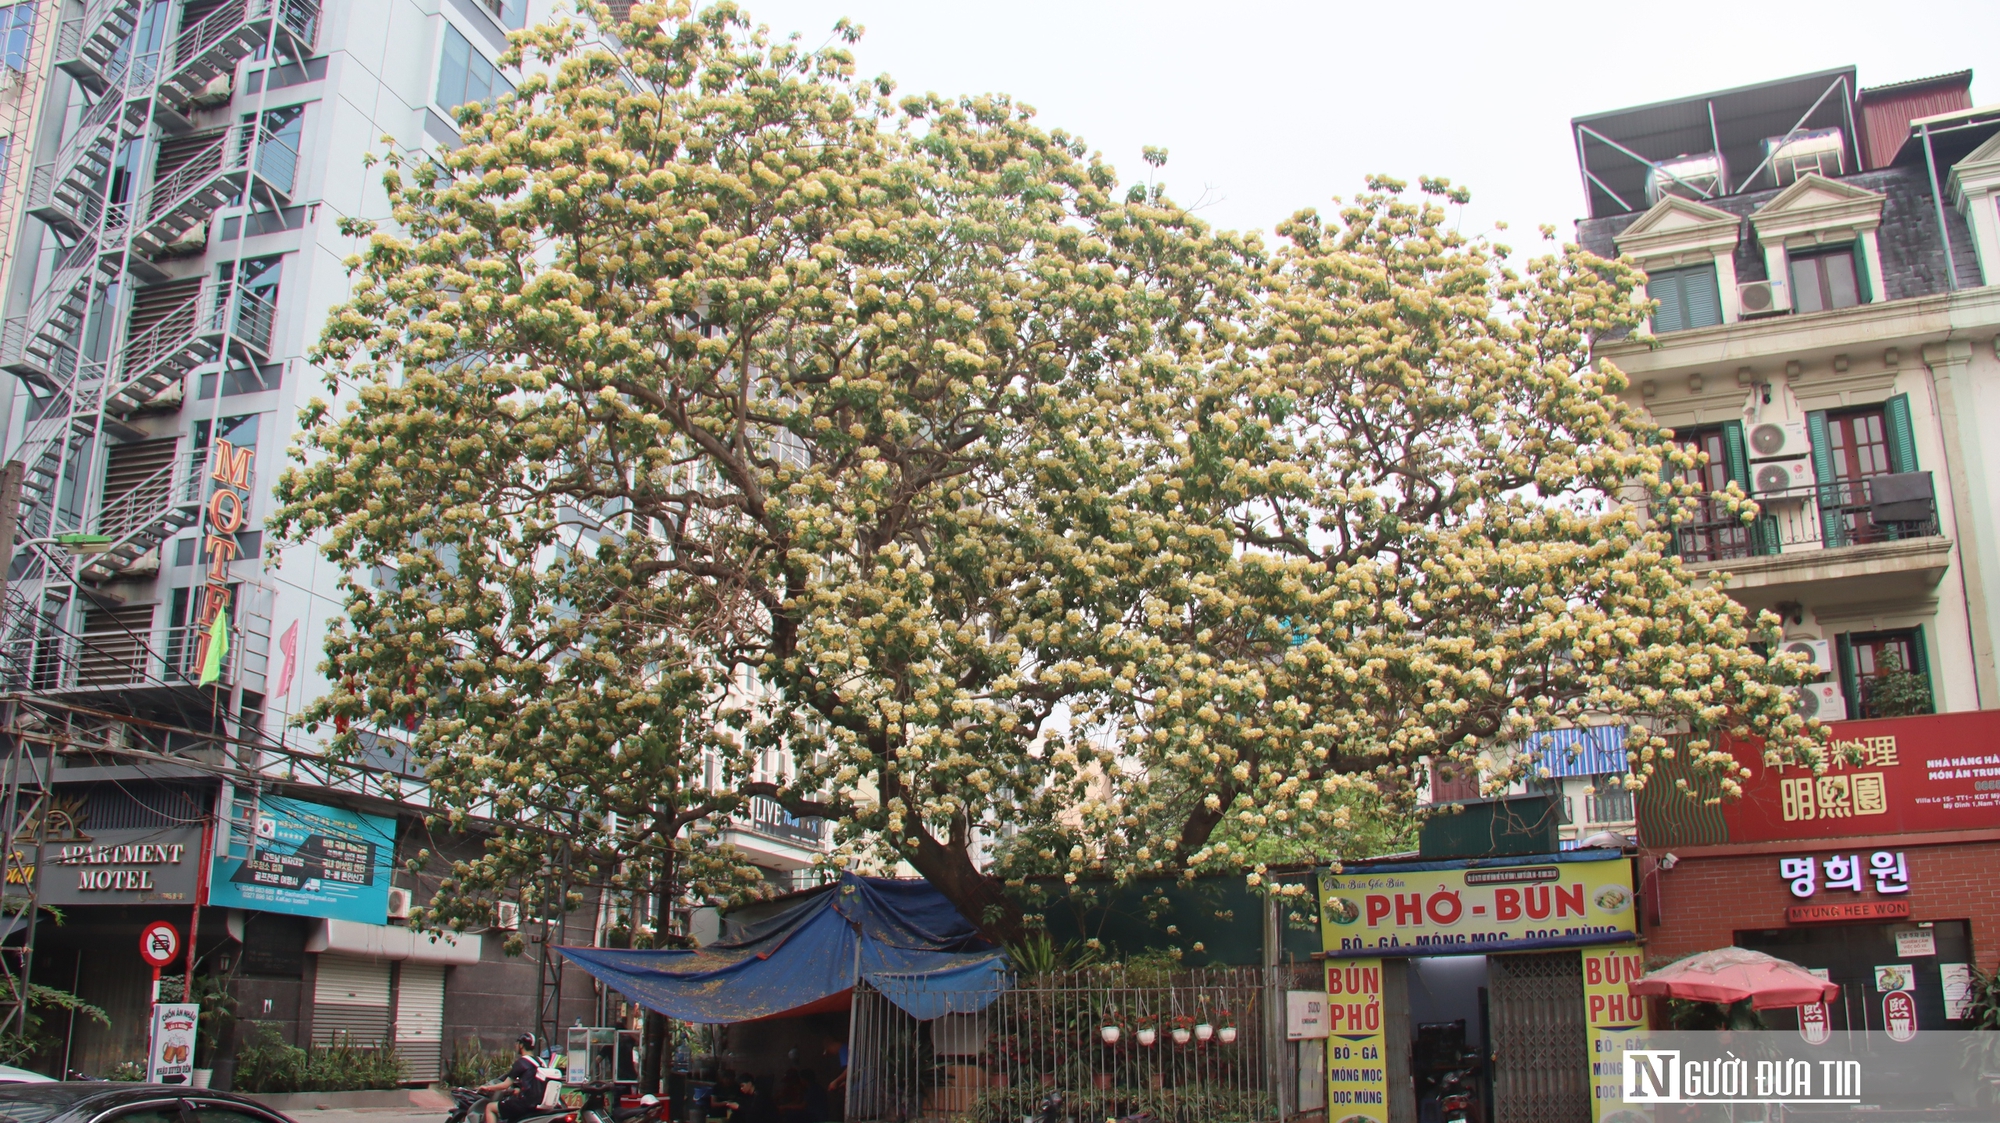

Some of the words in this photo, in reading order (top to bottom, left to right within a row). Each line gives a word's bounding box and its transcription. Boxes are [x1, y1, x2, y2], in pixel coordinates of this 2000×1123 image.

[1926, 757, 1950, 768] NHÀ
[1951, 755, 1982, 767] HÀNG
[1928, 770, 1953, 780] MÓN
[756, 797, 782, 827] LIVE
[57, 844, 185, 864] APARTMENT
[78, 870, 154, 890] MOTEL
[1348, 879, 1366, 890] Bún
[1386, 878, 1405, 889] Bún
[1779, 851, 1909, 898] 명희원
[1365, 883, 1463, 927] PHỞ
[1494, 881, 1586, 921] BÚN
[1792, 906, 1840, 919] MYUNG
[1844, 904, 1870, 916] HEE
[1874, 903, 1906, 915] WON
[1341, 933, 1363, 950] BÒ
[1378, 933, 1400, 949] GÀ
[1415, 931, 1466, 946] MÓNG
[1585, 950, 1641, 986] BÚN
[1328, 962, 1379, 995] BÚN
[1329, 995, 1380, 1031] PHỞ
[1334, 1044, 1350, 1060] BÒ
[1362, 1044, 1379, 1060] GÀ
[1594, 1036, 1613, 1053] BÒ
[1331, 1066, 1359, 1082] MÓNG
[1361, 1068, 1383, 1085] MỌC
[1593, 1060, 1623, 1076] MÓNG
[1333, 1090, 1352, 1107] DỌC
[1354, 1088, 1382, 1104] MÙNG
[1595, 1085, 1616, 1102] DỌC
